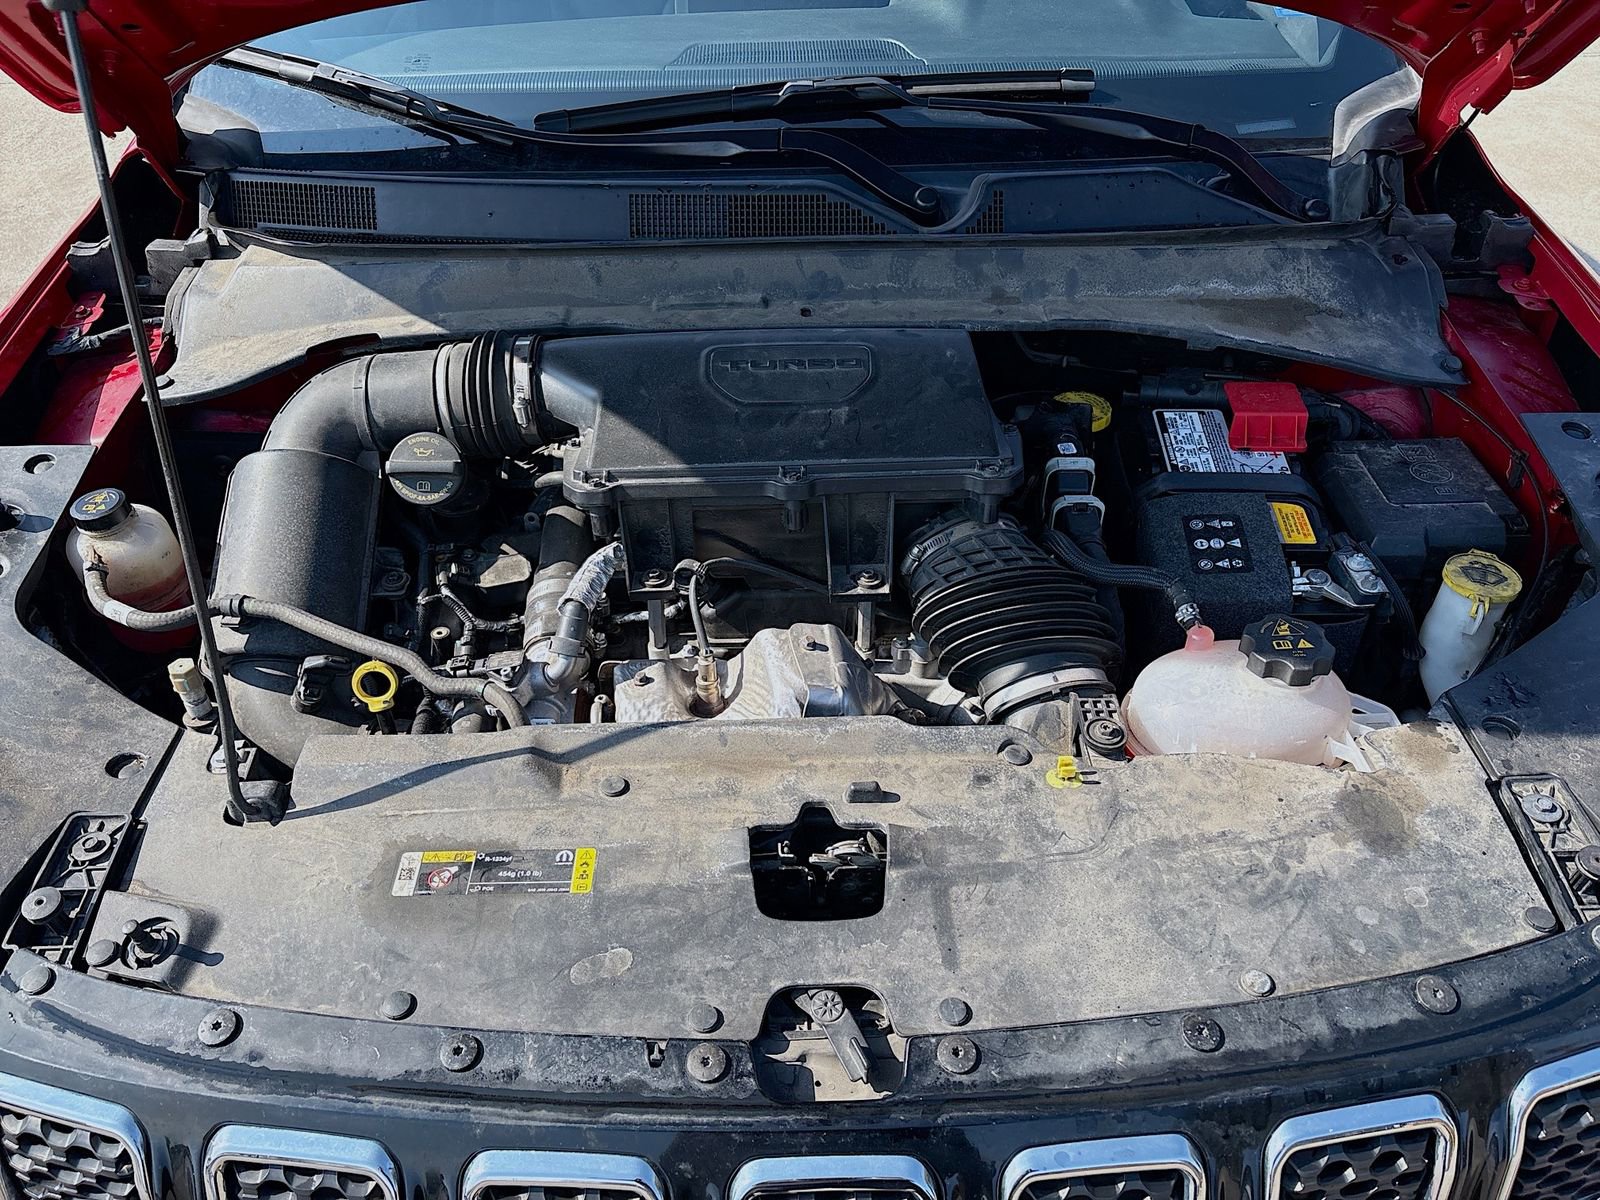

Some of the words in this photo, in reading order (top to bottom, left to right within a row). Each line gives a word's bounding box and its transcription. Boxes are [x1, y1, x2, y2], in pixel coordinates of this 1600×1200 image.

[719, 358, 864, 372] TURBO
[408, 436, 430, 445] ENGINE
[430, 437, 441, 446] OIL
[498, 870, 517, 878] 454g
[517, 870, 531, 878] (1.0
